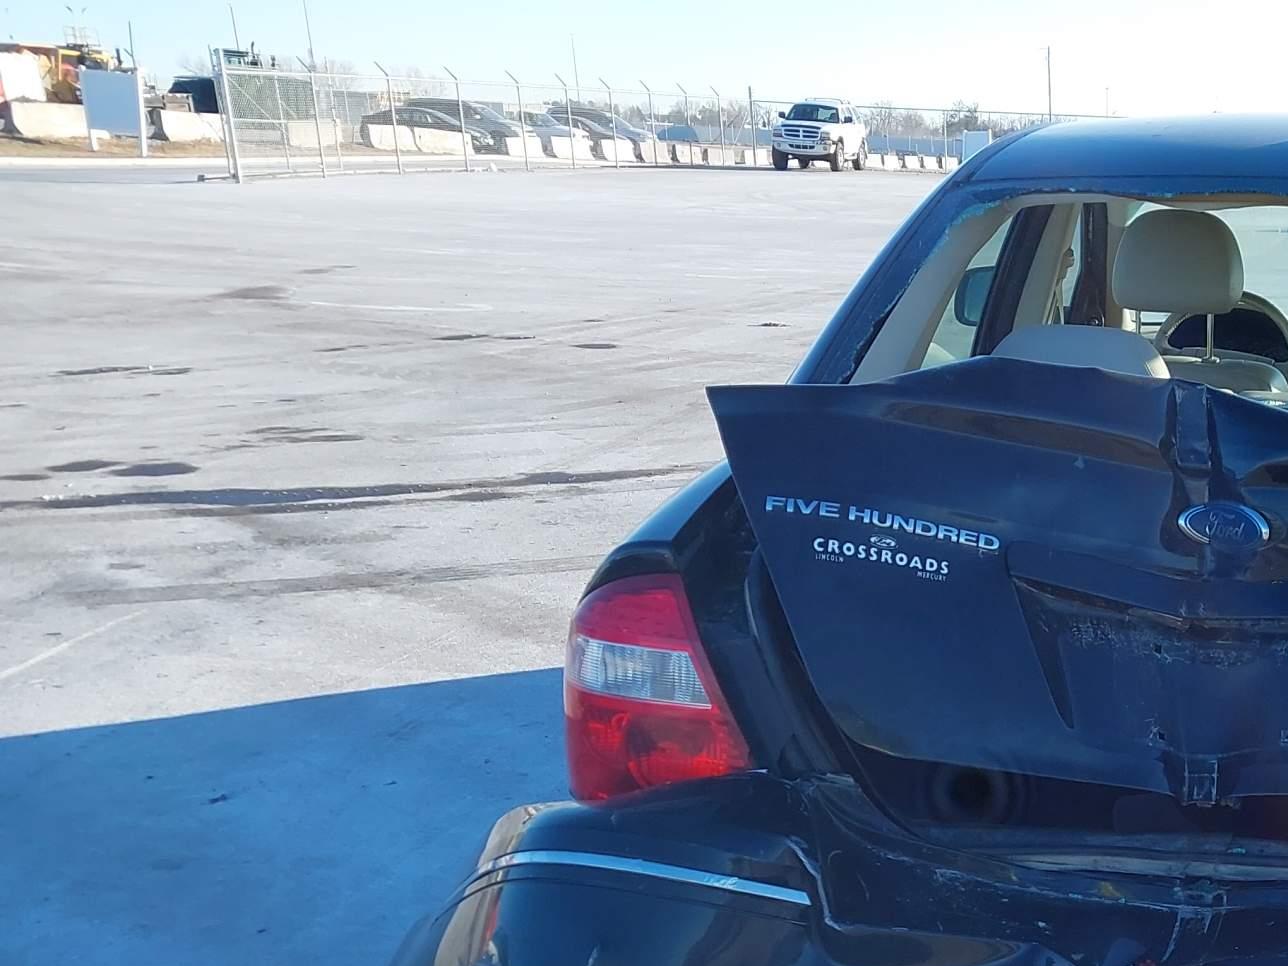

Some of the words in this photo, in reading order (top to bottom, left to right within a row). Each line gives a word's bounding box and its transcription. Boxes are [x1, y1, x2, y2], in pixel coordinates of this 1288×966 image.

[765, 495, 841, 518] FIVE
[848, 505, 1000, 550] HUNDRED
[1205, 511, 1245, 538] Ford
[813, 537, 949, 574] CROSSROADS
